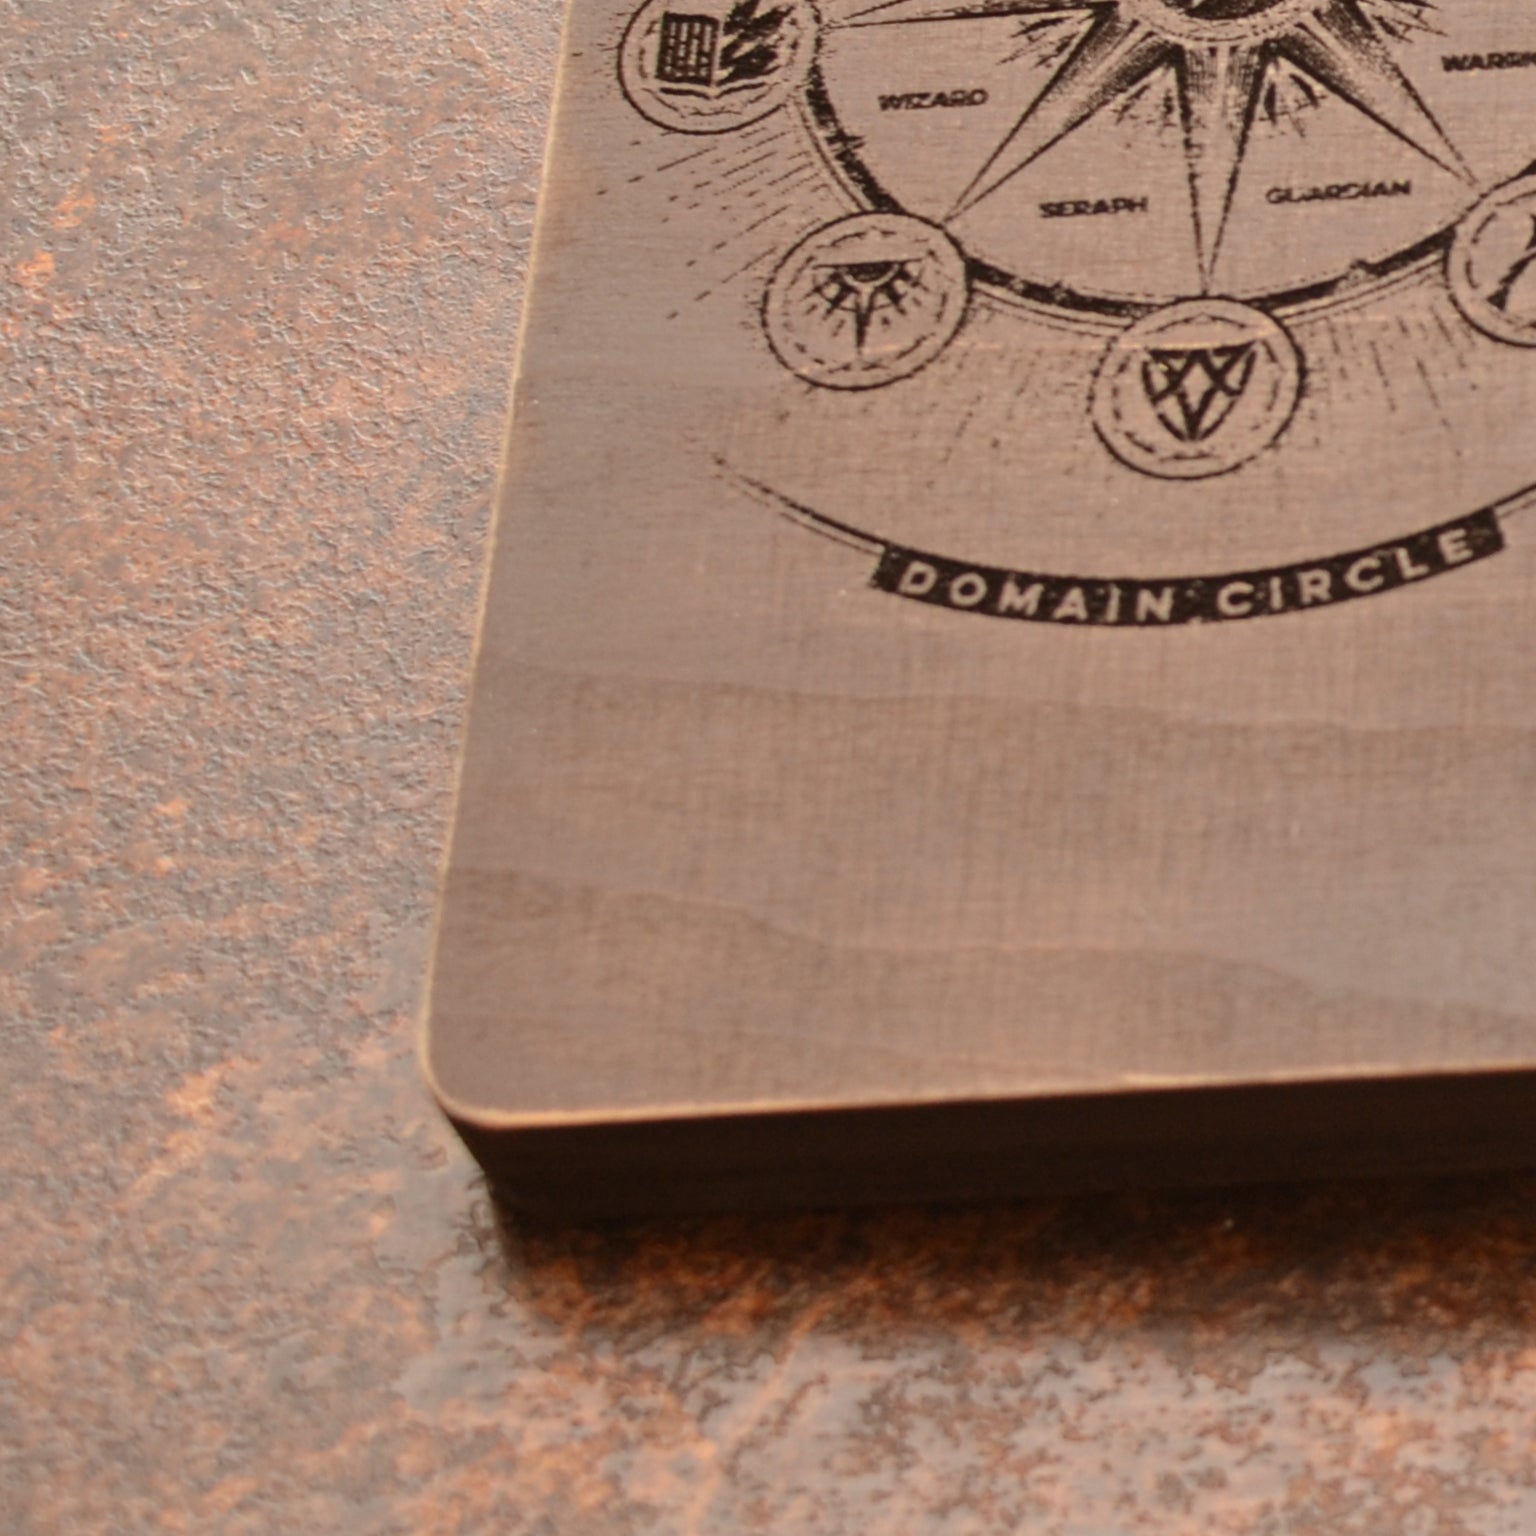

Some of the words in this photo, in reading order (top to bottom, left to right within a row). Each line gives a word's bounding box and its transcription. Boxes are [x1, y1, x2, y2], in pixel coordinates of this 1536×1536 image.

[878, 86, 990, 112] WIZARD
[1265, 178, 1411, 204] GUARDIAN
[1039, 194, 1149, 218] SERAPH
[898, 560, 1174, 624] DOMAIN
[1215, 526, 1474, 618] CIRCLE
